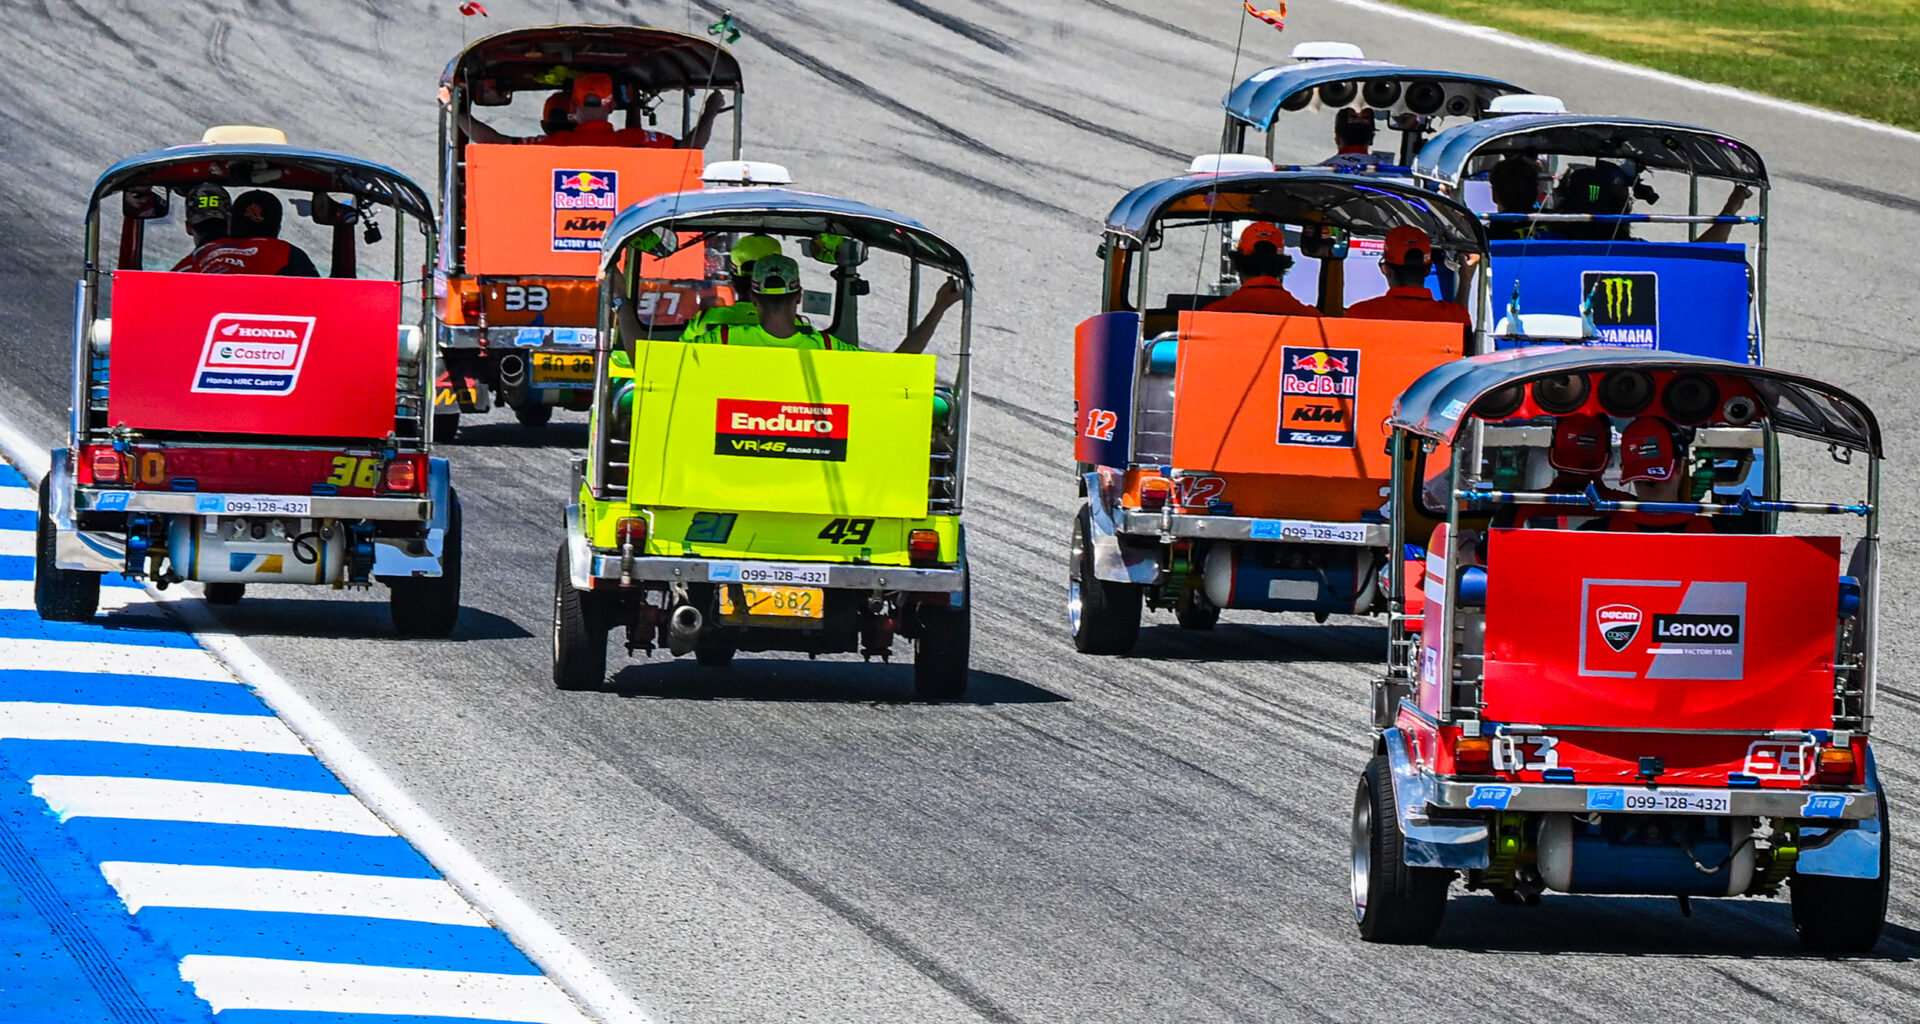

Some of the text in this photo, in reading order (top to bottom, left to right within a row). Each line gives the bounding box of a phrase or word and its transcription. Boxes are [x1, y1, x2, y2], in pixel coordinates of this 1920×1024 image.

[198, 196, 219, 208] 36
[555, 192, 615, 209] Red Bull
[563, 216, 607, 231] KTM
[554, 239, 586, 248] FACTORY
[505, 286, 549, 311] 33
[637, 291, 681, 316] 37
[239, 327, 298, 339] HONDA
[579, 333, 596, 342] 09
[1602, 328, 1654, 343] YAMAHA
[234, 348, 286, 360] Castrol
[573, 358, 595, 372] 36
[205, 376, 285, 387] Honda HRC Castrol
[1283, 373, 1355, 396] Red Bull
[781, 405, 833, 415] PERTAMINA
[1291, 404, 1344, 423] KTM
[731, 412, 833, 433] Enduro
[1085, 408, 1118, 441] 12
[327, 456, 380, 489] 36
[1647, 466, 1666, 475] 63
[1173, 476, 1227, 508] 12
[226, 501, 308, 513] 099-128-4321
[684, 511, 739, 544] 21
[817, 518, 876, 545] 49
[1282, 527, 1364, 541] 099-128-4321
[741, 570, 828, 582] 099-128-4321
[1601, 611, 1638, 621] DUCATI
[1658, 619, 1733, 637] Lenovo
[1492, 735, 1559, 771] 63
[1626, 796, 1727, 811] 099-128-4321
